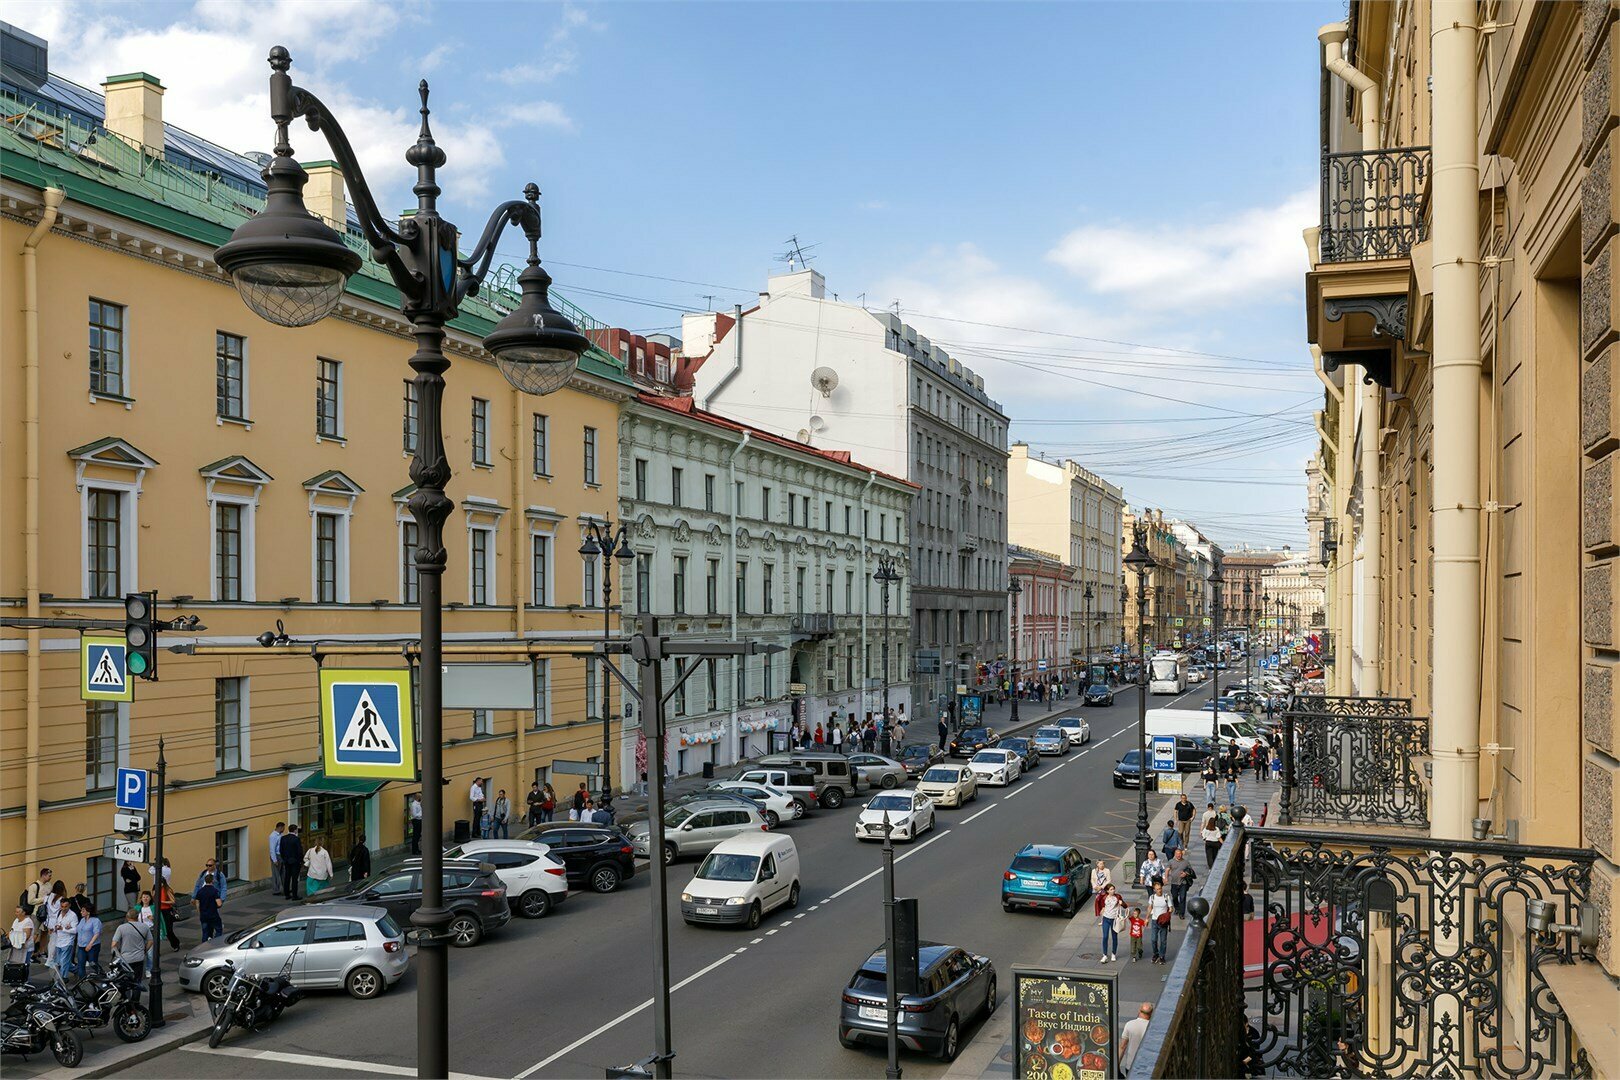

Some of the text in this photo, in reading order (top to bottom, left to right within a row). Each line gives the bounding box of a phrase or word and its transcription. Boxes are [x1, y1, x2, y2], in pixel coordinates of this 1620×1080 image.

[124, 773, 141, 803] P
[1028, 1008, 1100, 1023] Taste of India
[1037, 1019, 1091, 1032] Вкус Индии
